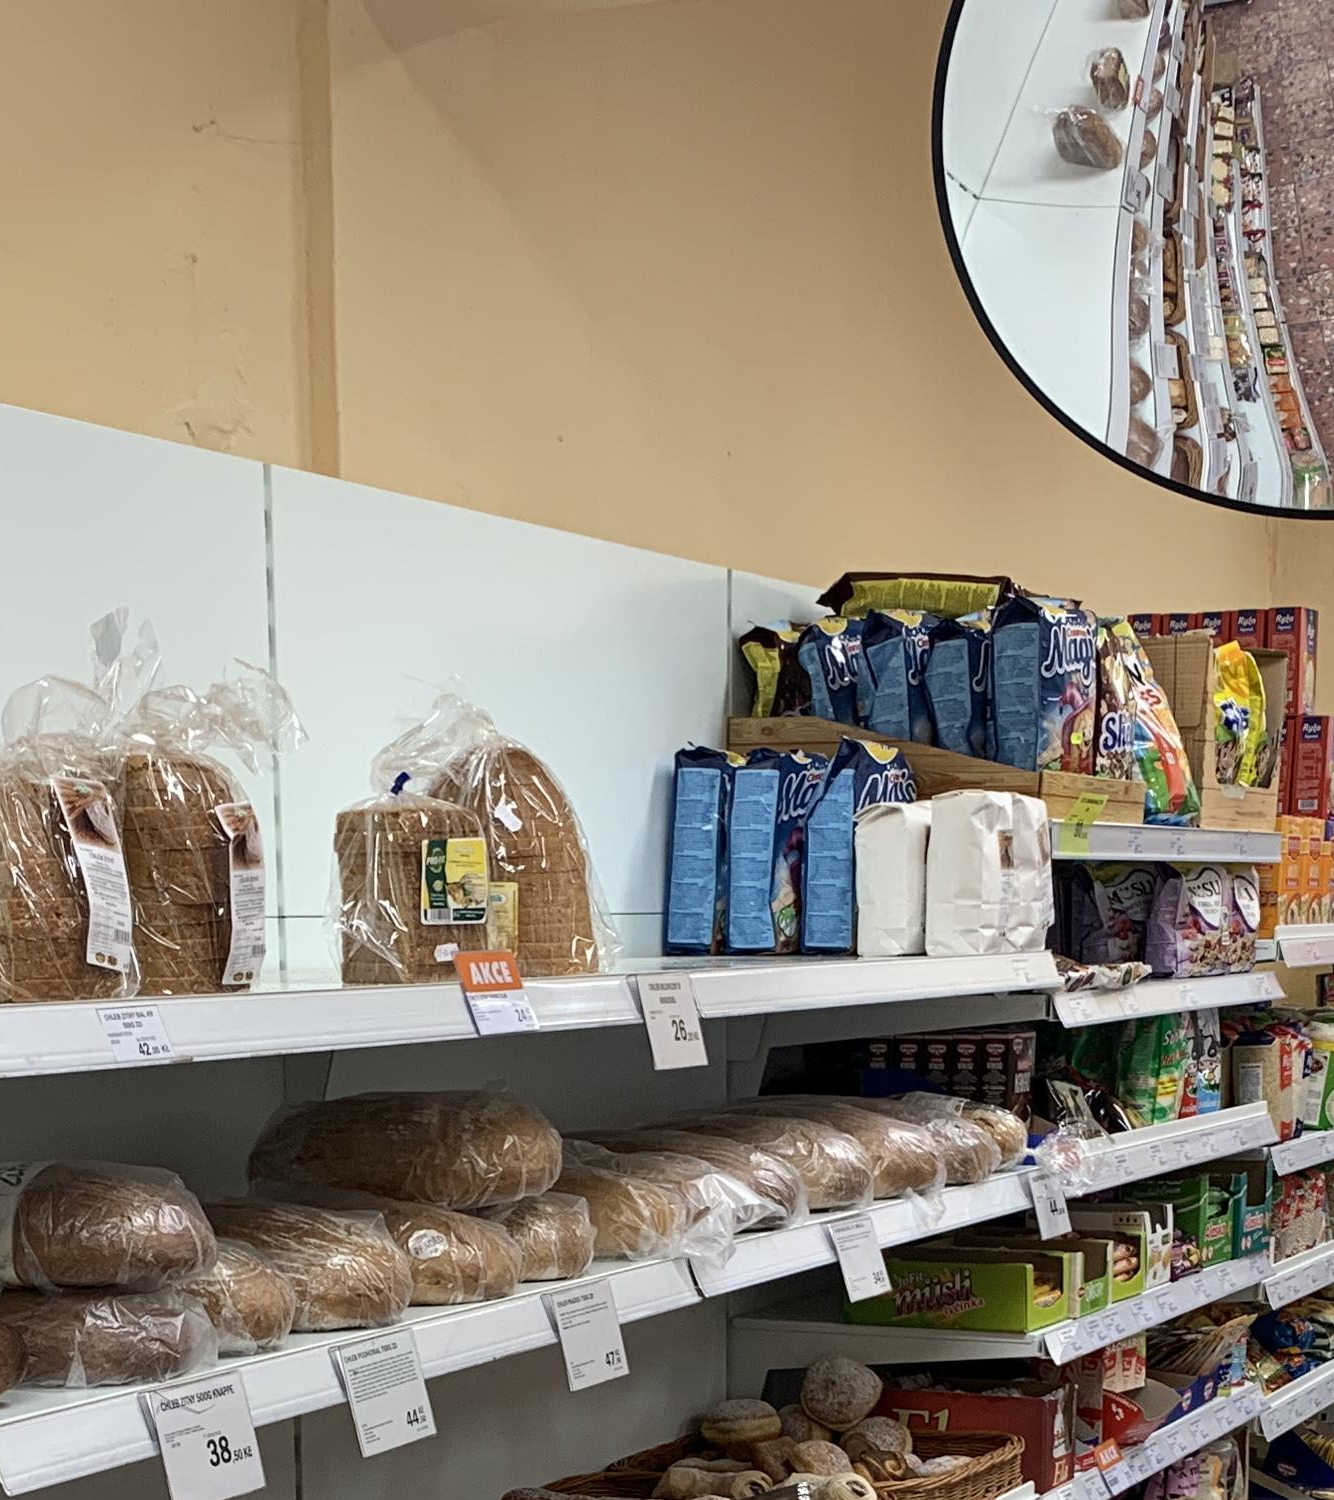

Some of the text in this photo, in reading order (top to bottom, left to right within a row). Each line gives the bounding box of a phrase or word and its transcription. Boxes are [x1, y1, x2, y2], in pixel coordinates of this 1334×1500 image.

[469, 960, 512, 986] AKCE
[671, 1020, 687, 1042] 26
[138, 1042, 152, 1056] 42
[895, 1270, 972, 1316] müsli
[406, 1410, 419, 1427] 44
[207, 1435, 232, 1467] 38
